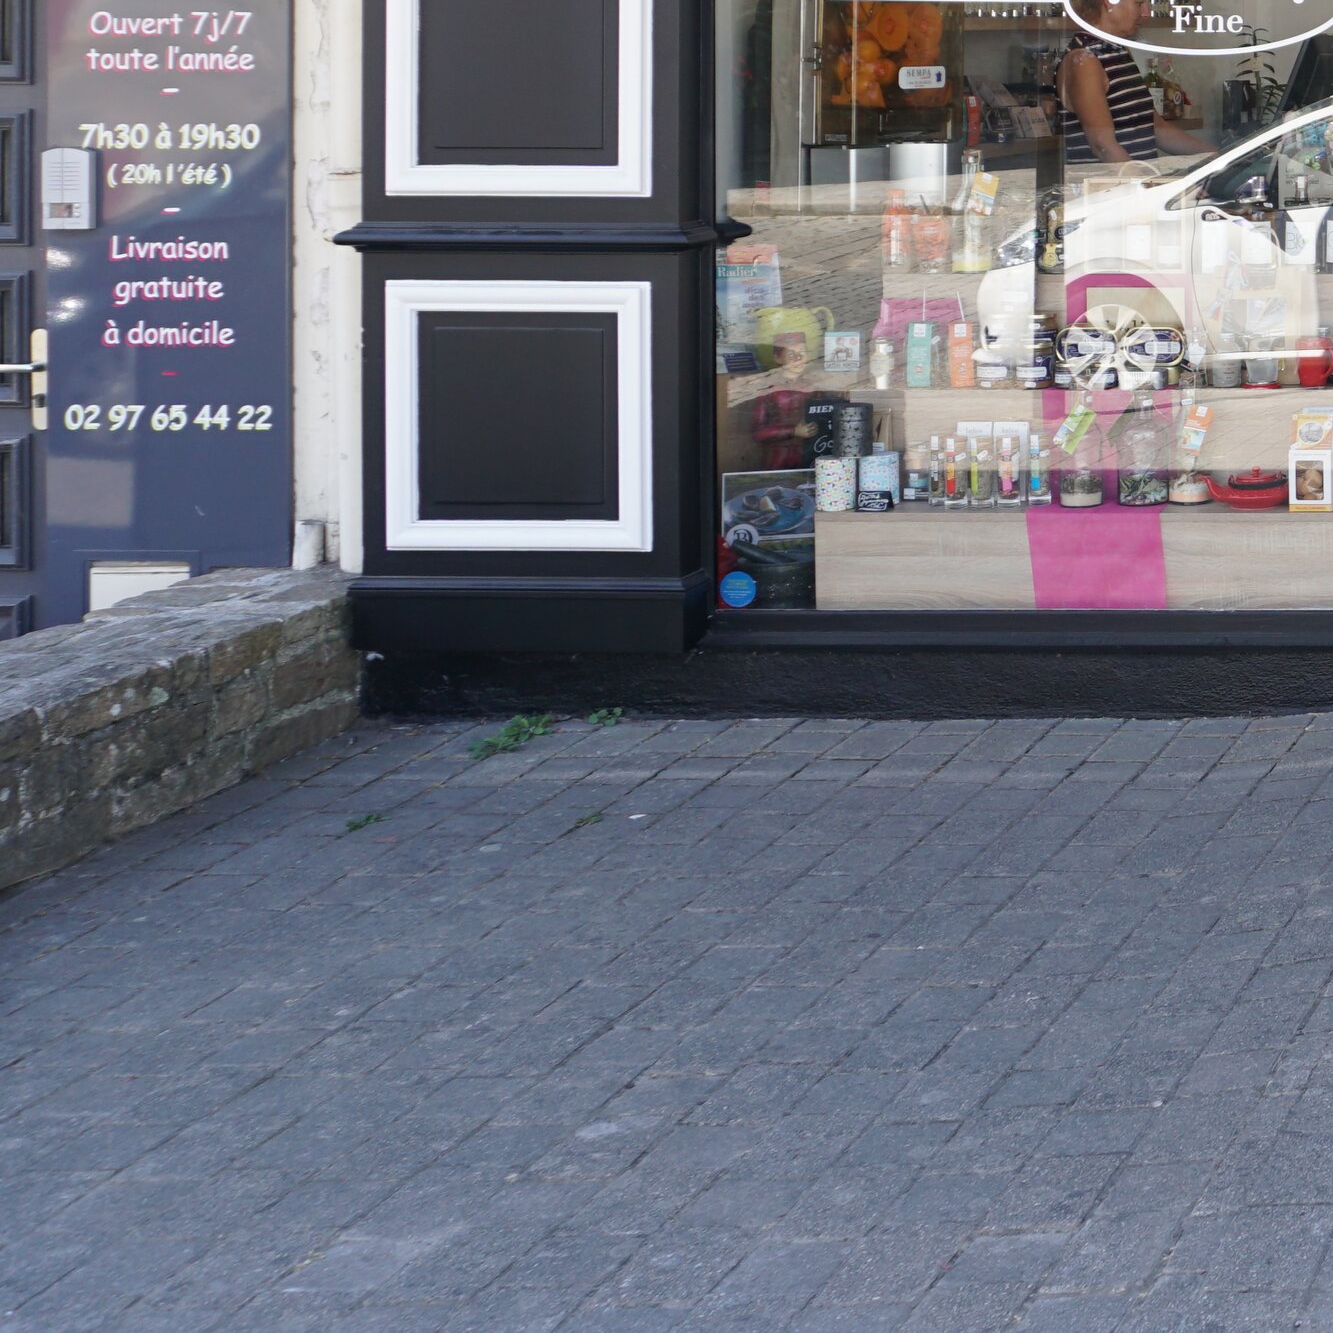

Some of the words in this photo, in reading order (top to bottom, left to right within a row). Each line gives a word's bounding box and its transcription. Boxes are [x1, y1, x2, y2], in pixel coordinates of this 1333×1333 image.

[89, 10, 184, 36] Ouvert
[190, 9, 253, 42] 7j/7
[1171, 4, 1244, 34] Fine
[85, 47, 160, 71] toute
[167, 44, 256, 72] l'année
[78, 122, 150, 150] 7h30
[154, 121, 173, 150] à
[178, 122, 261, 150] 19h30
[111, 235, 229, 260] Livraison
[115, 275, 224, 307] gratuite
[103, 319, 120, 345] à
[127, 319, 235, 345] domicile
[65, 404, 101, 431] 02
[108, 404, 145, 431] 97
[151, 404, 187, 431] 65
[193, 404, 231, 431] 44
[237, 404, 273, 431] 22
